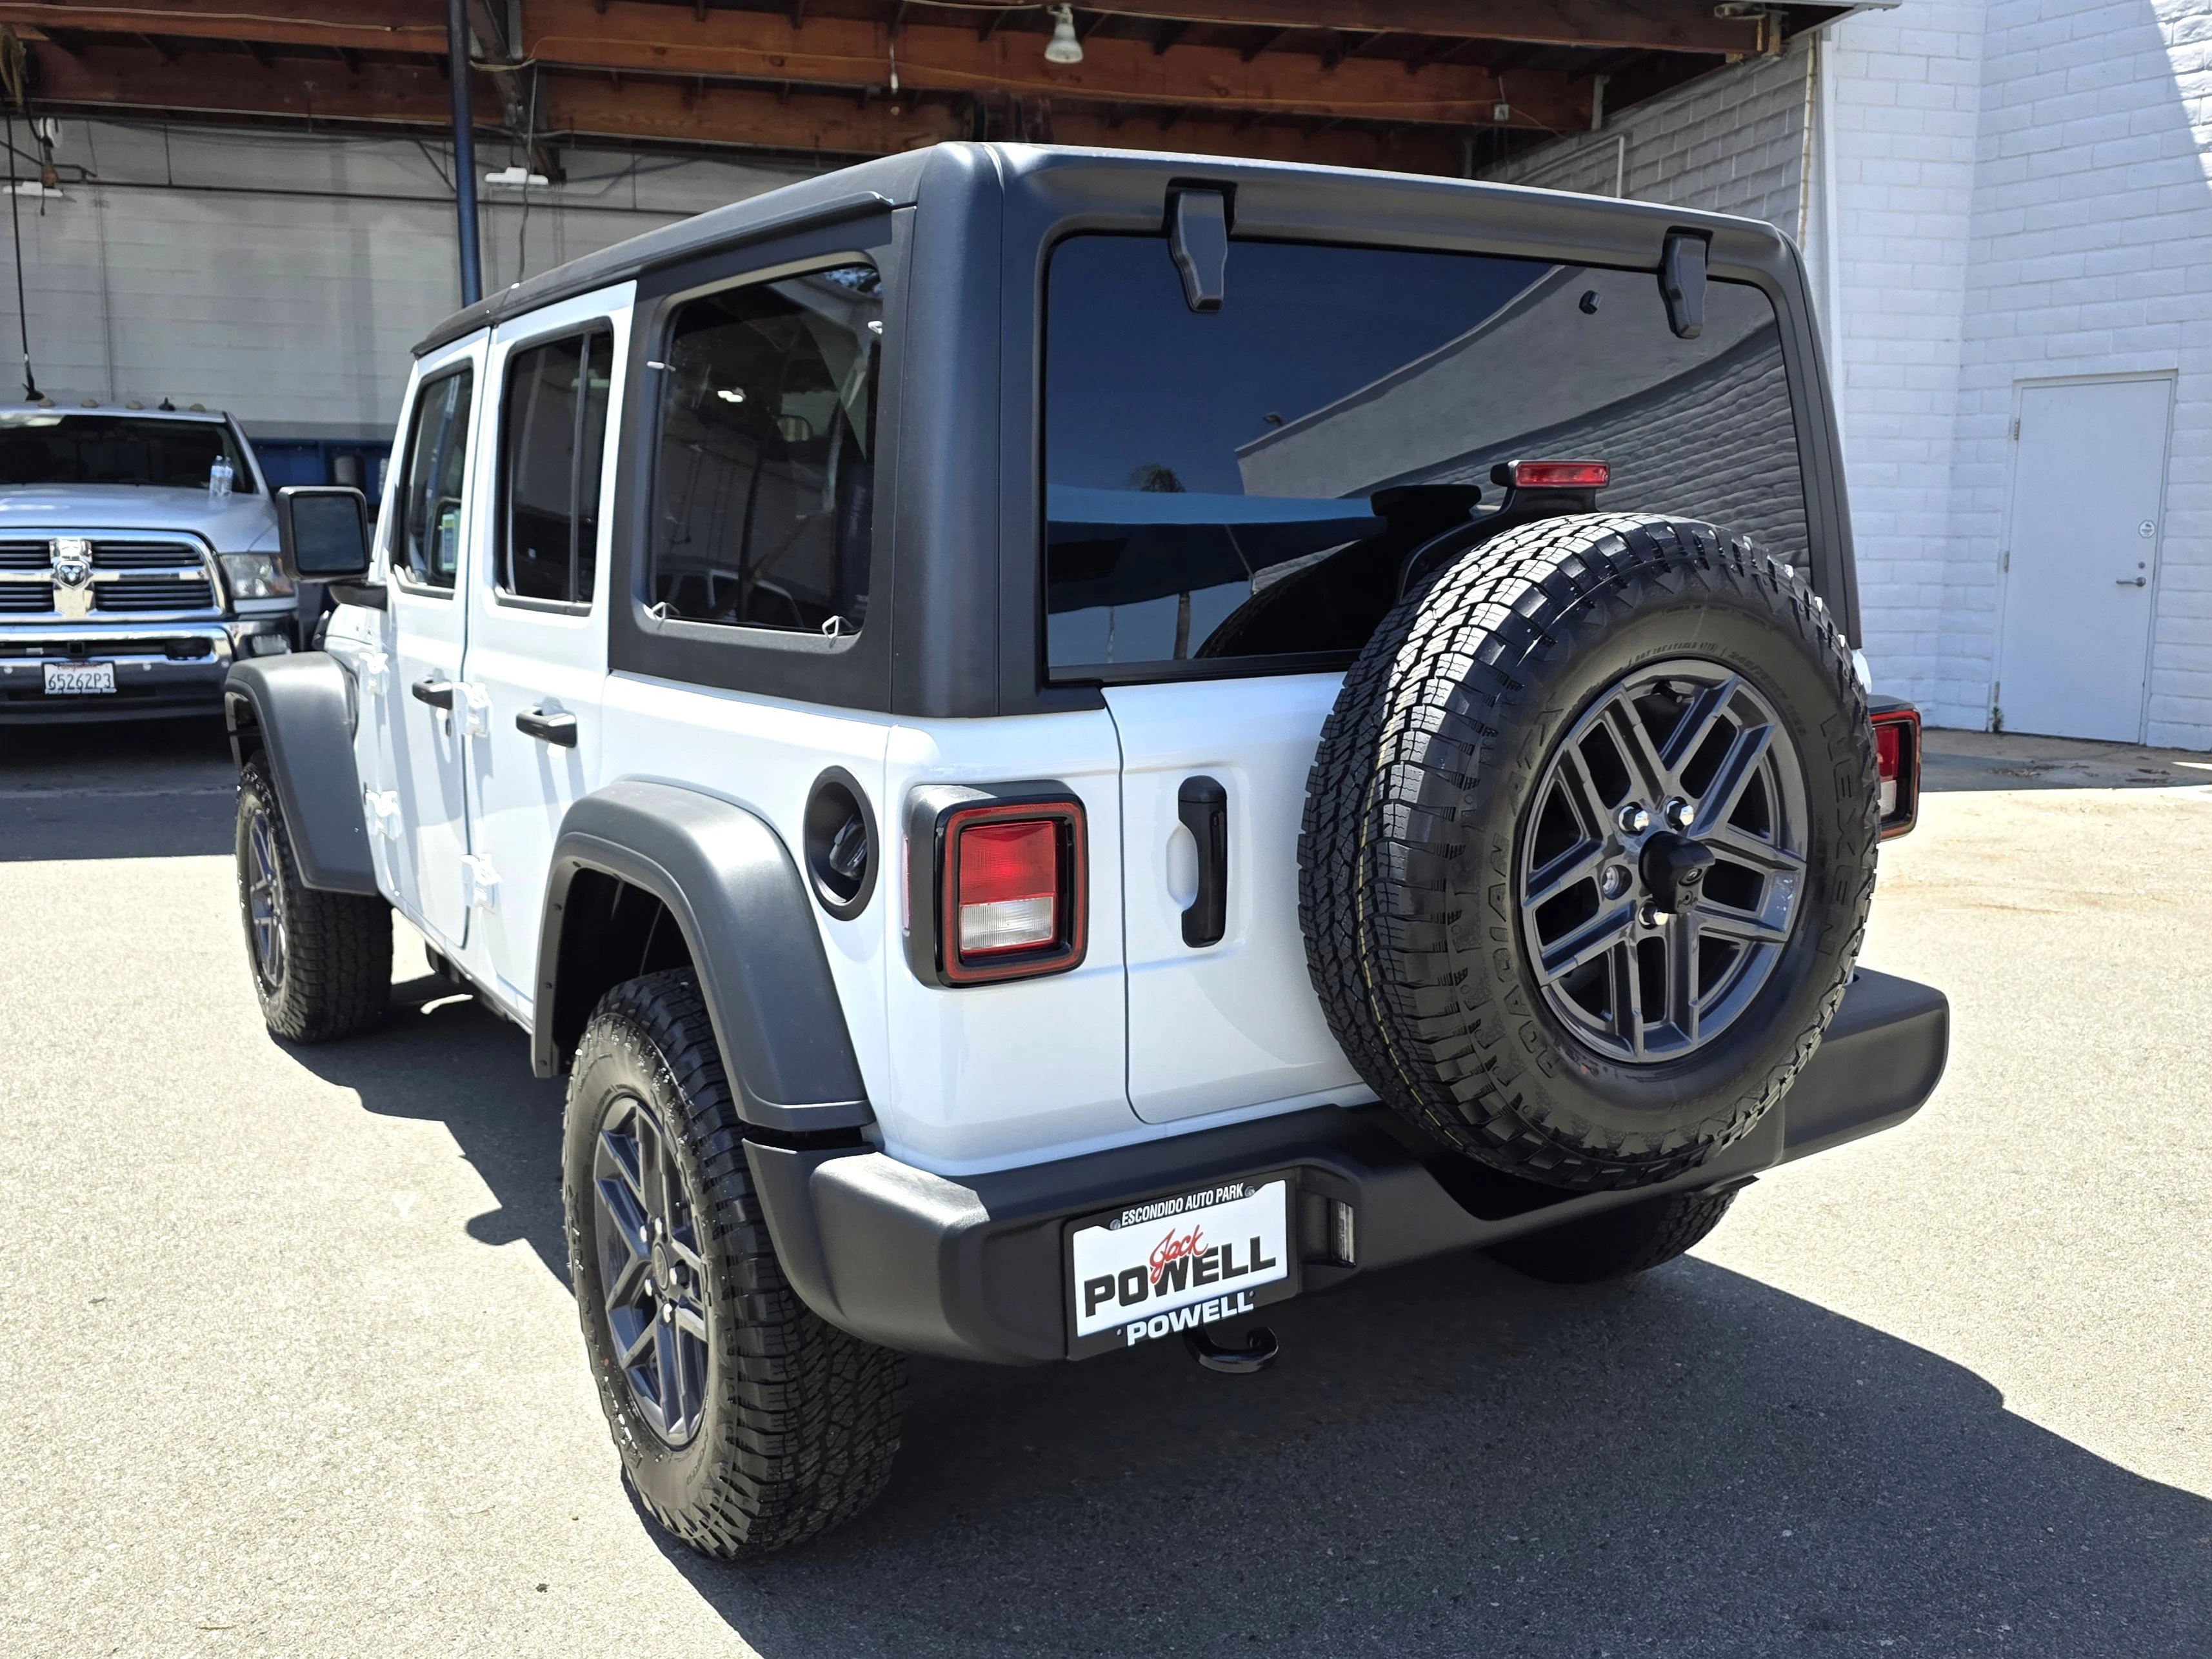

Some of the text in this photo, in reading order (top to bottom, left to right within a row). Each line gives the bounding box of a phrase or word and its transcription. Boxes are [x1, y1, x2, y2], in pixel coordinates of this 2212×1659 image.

[48, 673, 111, 690] 65262P3
[1121, 1182, 1244, 1227] ESCONDIDO AUTO PARK
[1084, 1235, 1277, 1318] POWELL
[1149, 1224, 1208, 1285] Jack
[1126, 1291, 1255, 1347] POWELL
